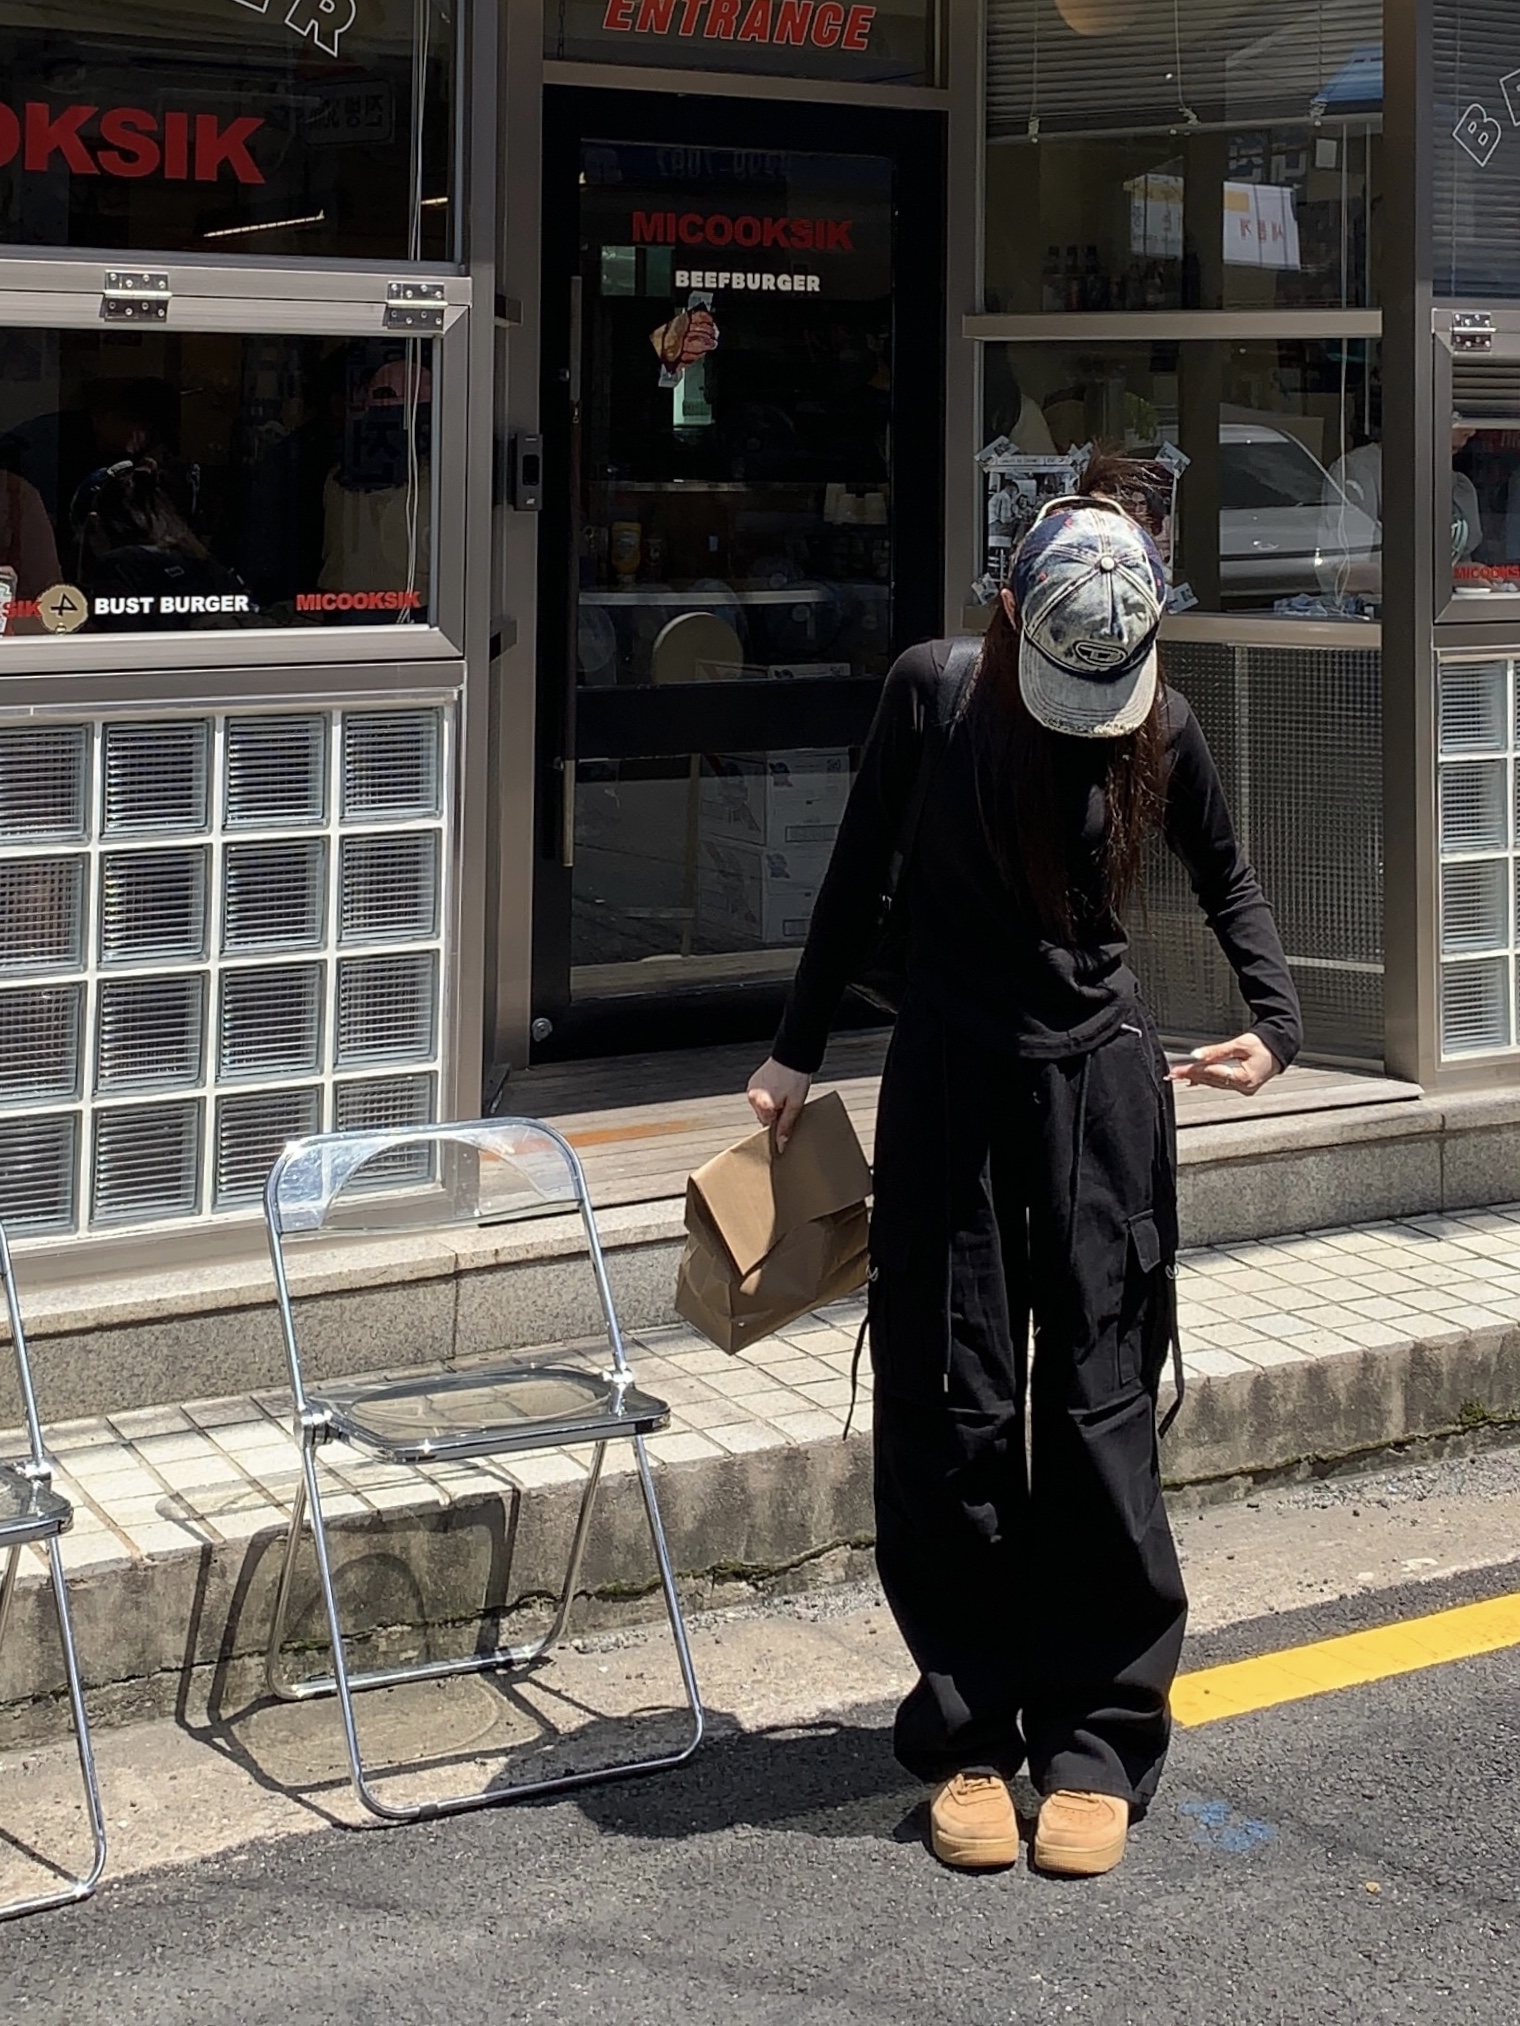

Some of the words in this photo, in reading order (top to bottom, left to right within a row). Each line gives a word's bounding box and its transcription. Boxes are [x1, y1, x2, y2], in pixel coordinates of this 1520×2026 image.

[603, 0, 876, 51] ENTRANCE
[632, 212, 854, 251] MICOOKSIK
[675, 271, 821, 292] BEEFBURGER
[94, 596, 154, 615] BUST
[160, 594, 250, 614] BURGER
[296, 592, 421, 611] MICOOKSIK
